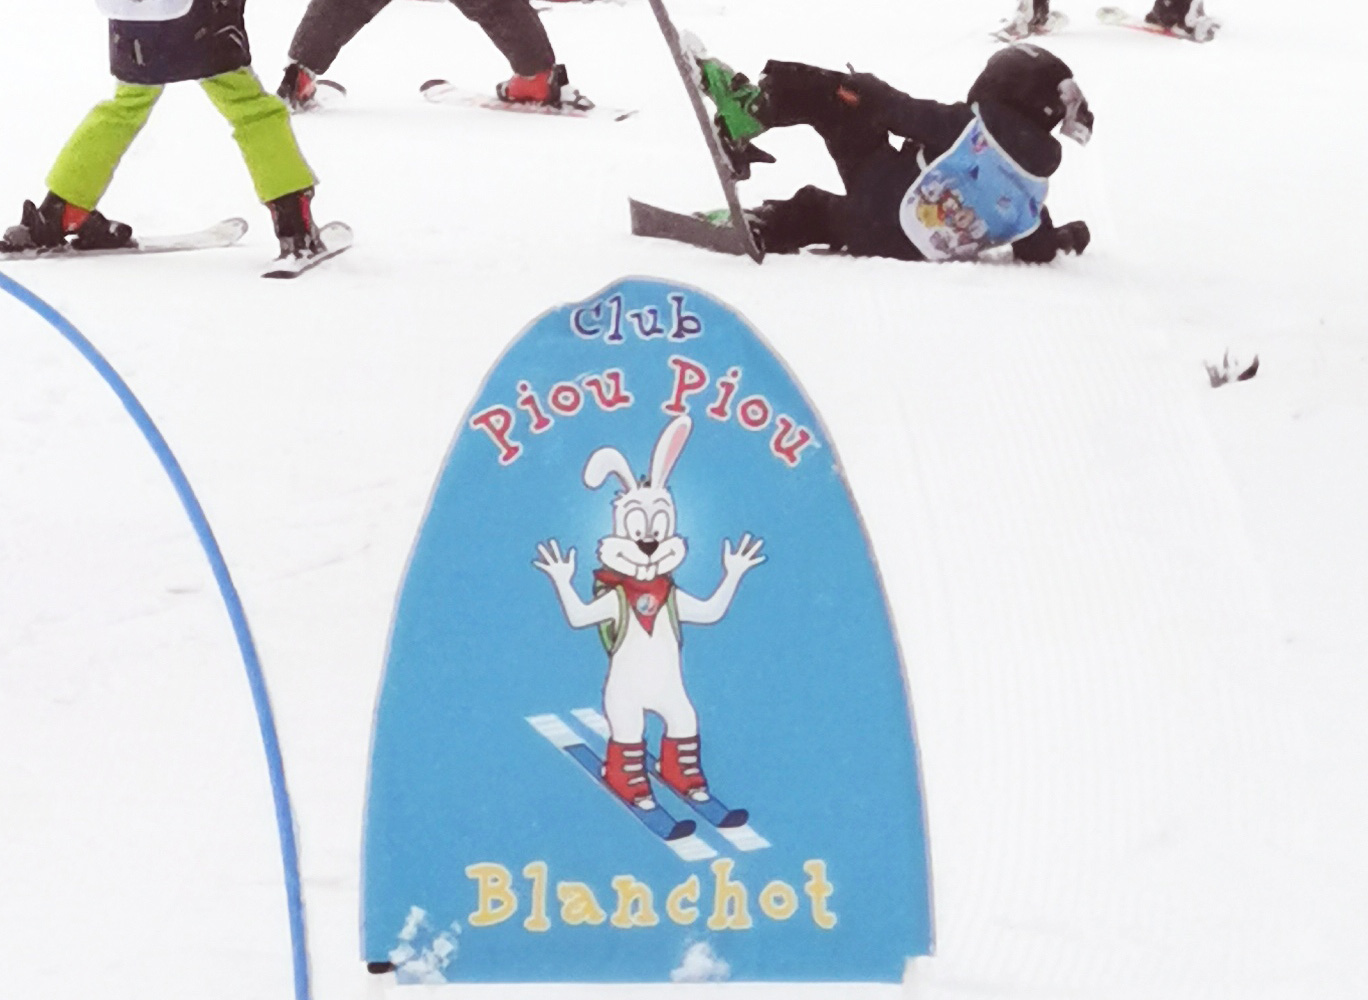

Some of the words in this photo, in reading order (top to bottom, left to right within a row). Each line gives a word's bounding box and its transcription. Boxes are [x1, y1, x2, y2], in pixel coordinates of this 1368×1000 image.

[471, 370, 633, 464] Piou
[662, 355, 816, 467] Piou
[465, 858, 838, 932] Blanchot
